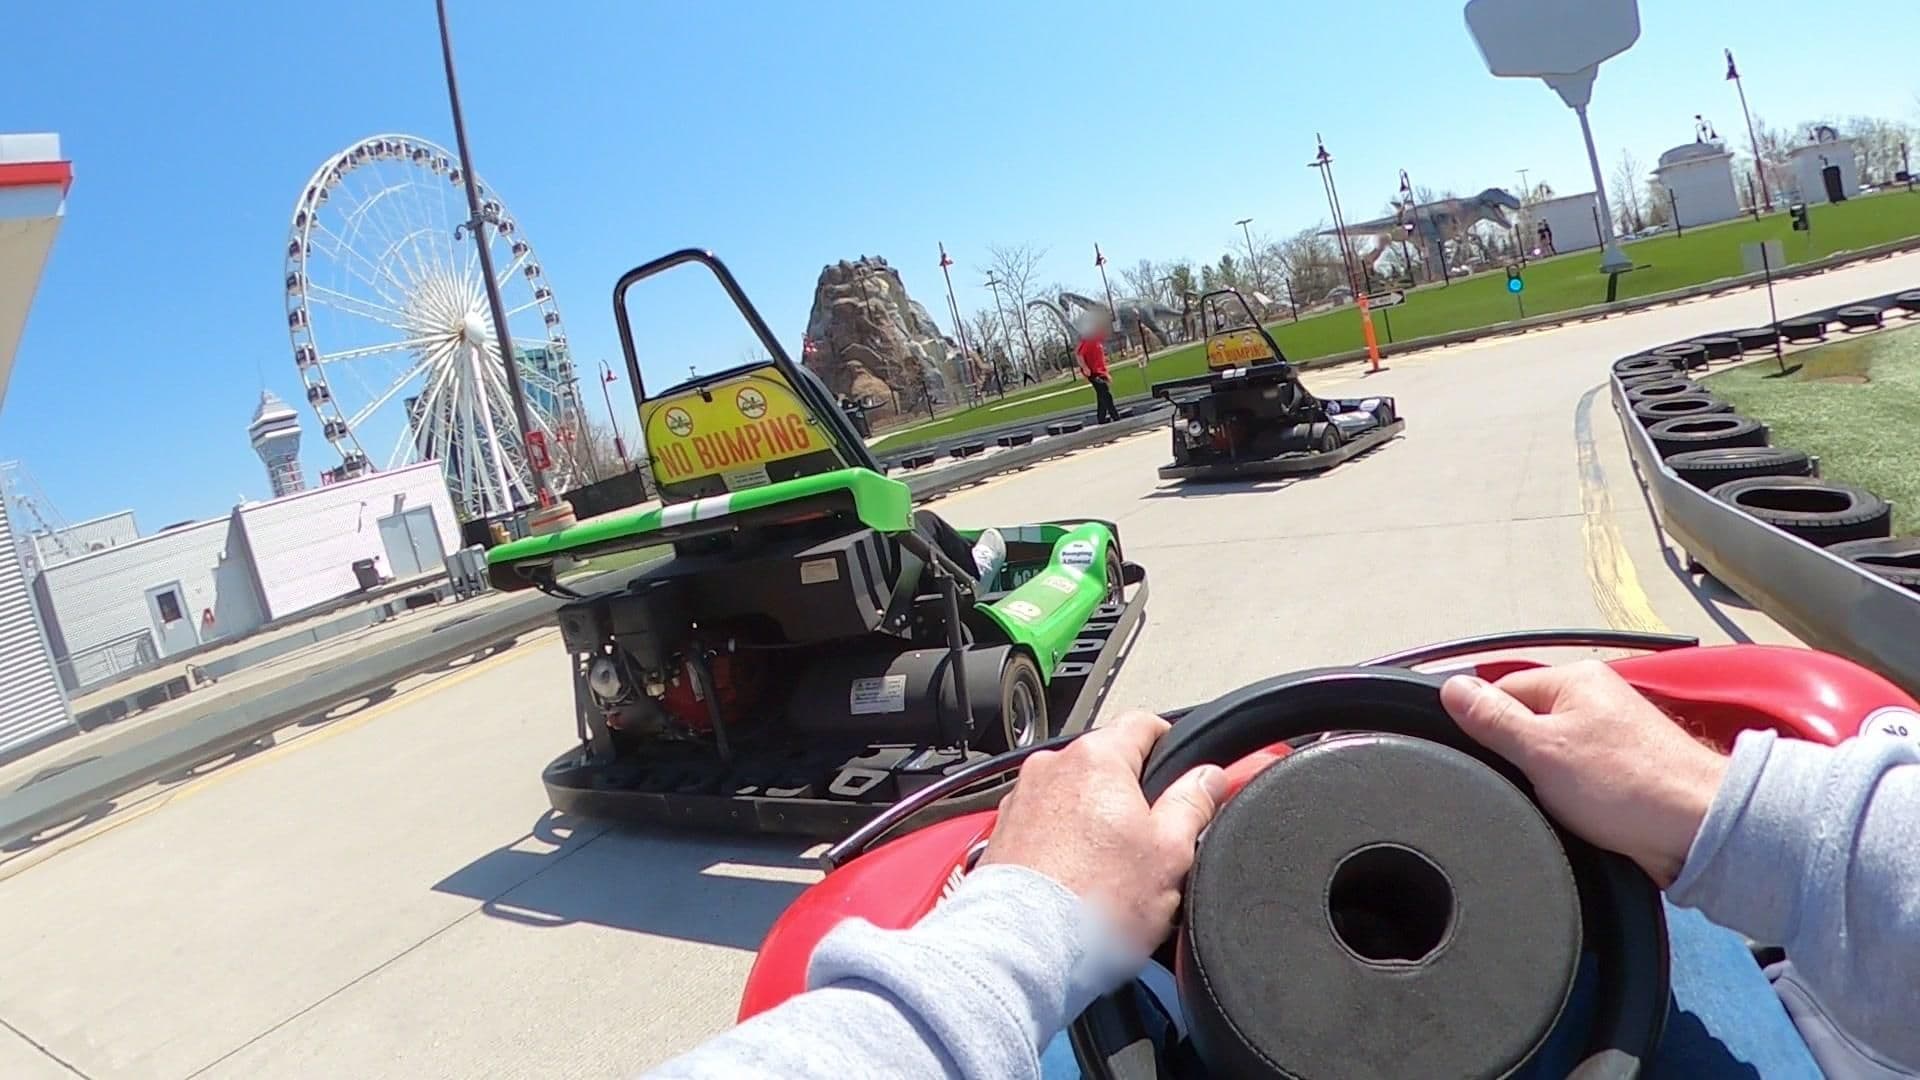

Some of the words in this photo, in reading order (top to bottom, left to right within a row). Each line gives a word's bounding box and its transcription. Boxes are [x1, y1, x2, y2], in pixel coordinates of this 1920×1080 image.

[1224, 343, 1267, 362] BUMPING
[656, 441, 694, 478] NO
[692, 413, 810, 470] BUMPING
